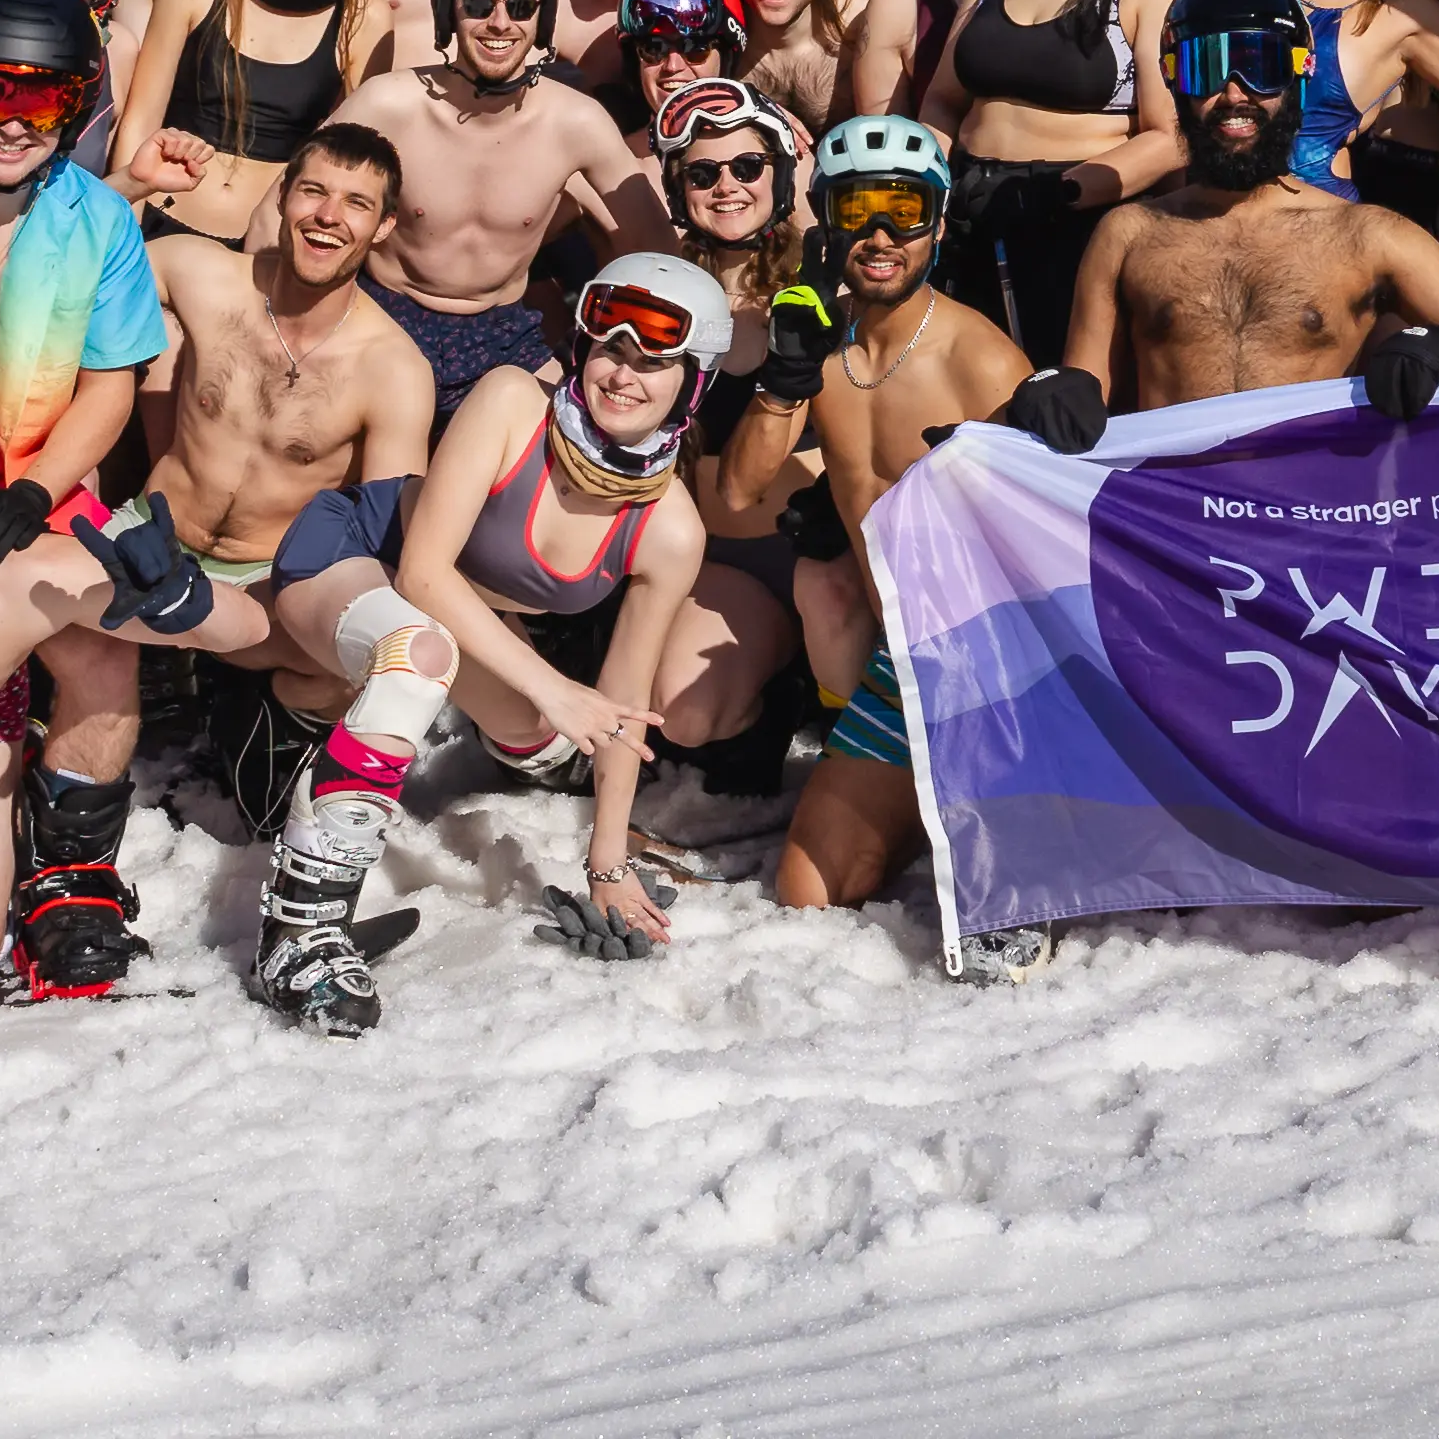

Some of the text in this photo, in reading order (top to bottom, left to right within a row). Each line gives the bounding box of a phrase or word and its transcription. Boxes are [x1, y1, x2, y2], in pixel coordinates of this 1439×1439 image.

[1203, 495, 1257, 518] Not
[1265, 505, 1284, 519] a
[1291, 495, 1422, 525] stranger
